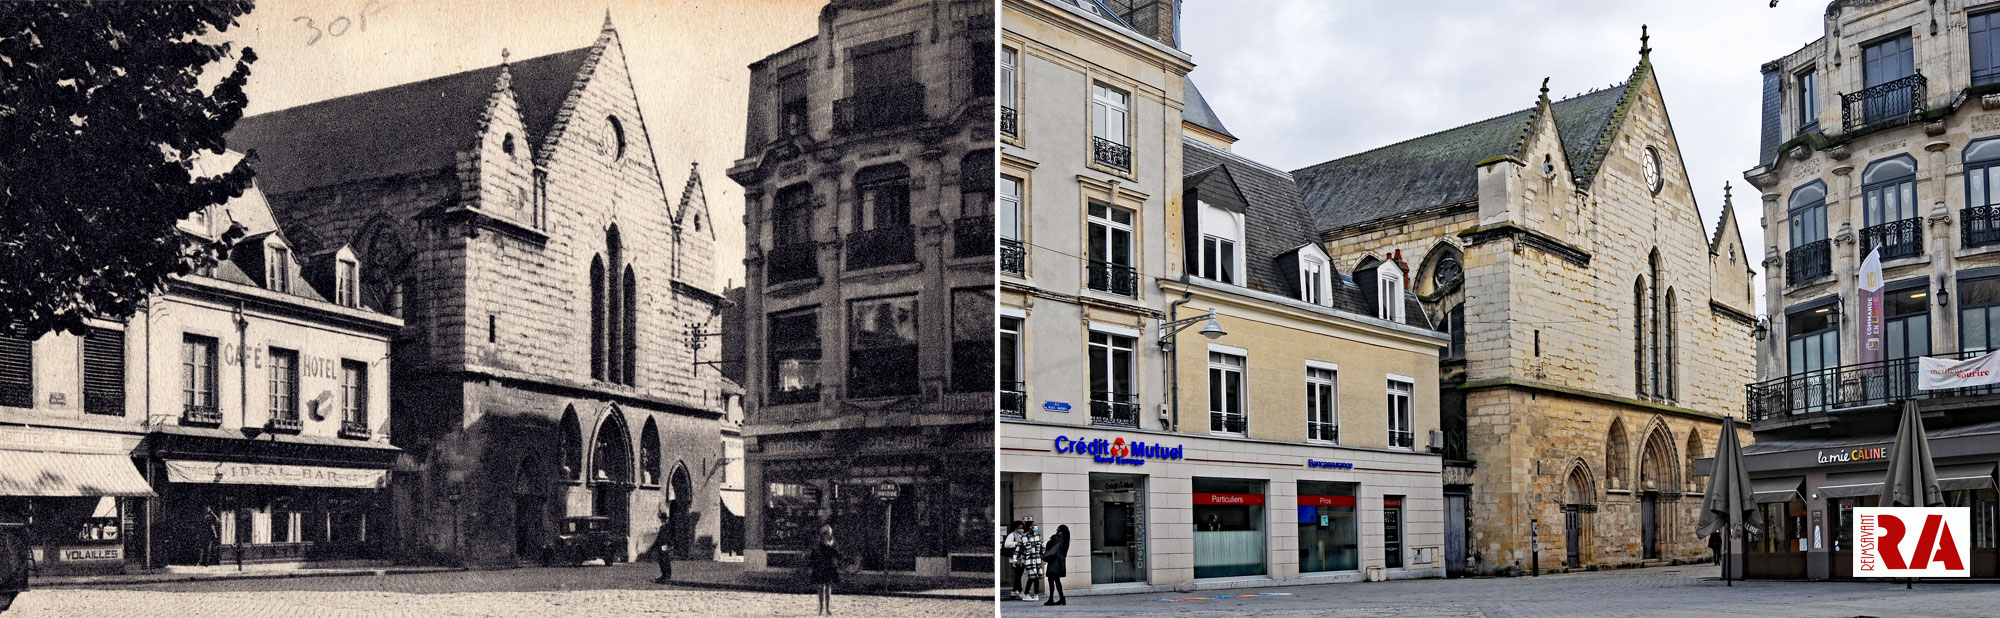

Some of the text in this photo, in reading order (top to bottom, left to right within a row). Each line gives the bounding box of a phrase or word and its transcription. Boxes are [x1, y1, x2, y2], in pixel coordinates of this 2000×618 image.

[1873, 325, 1879, 334] EN
[224, 343, 262, 369] CAFÉ
[304, 354, 337, 379] HOTEL
[1956, 369, 1990, 379] sourire
[1055, 435, 1183, 459] Crédit Mutuel
[1818, 446, 1887, 463] la mie CÂLINE
[1094, 455, 1145, 466] Nord Europe
[1308, 459, 1353, 469] Bancassurance
[232, 466, 286, 478] IDEAL
[302, 469, 338, 482] BAR
[1211, 495, 1244, 503] Particuliers
[1319, 497, 1332, 505] Pros
[66, 550, 118, 560] VOLAILLES
